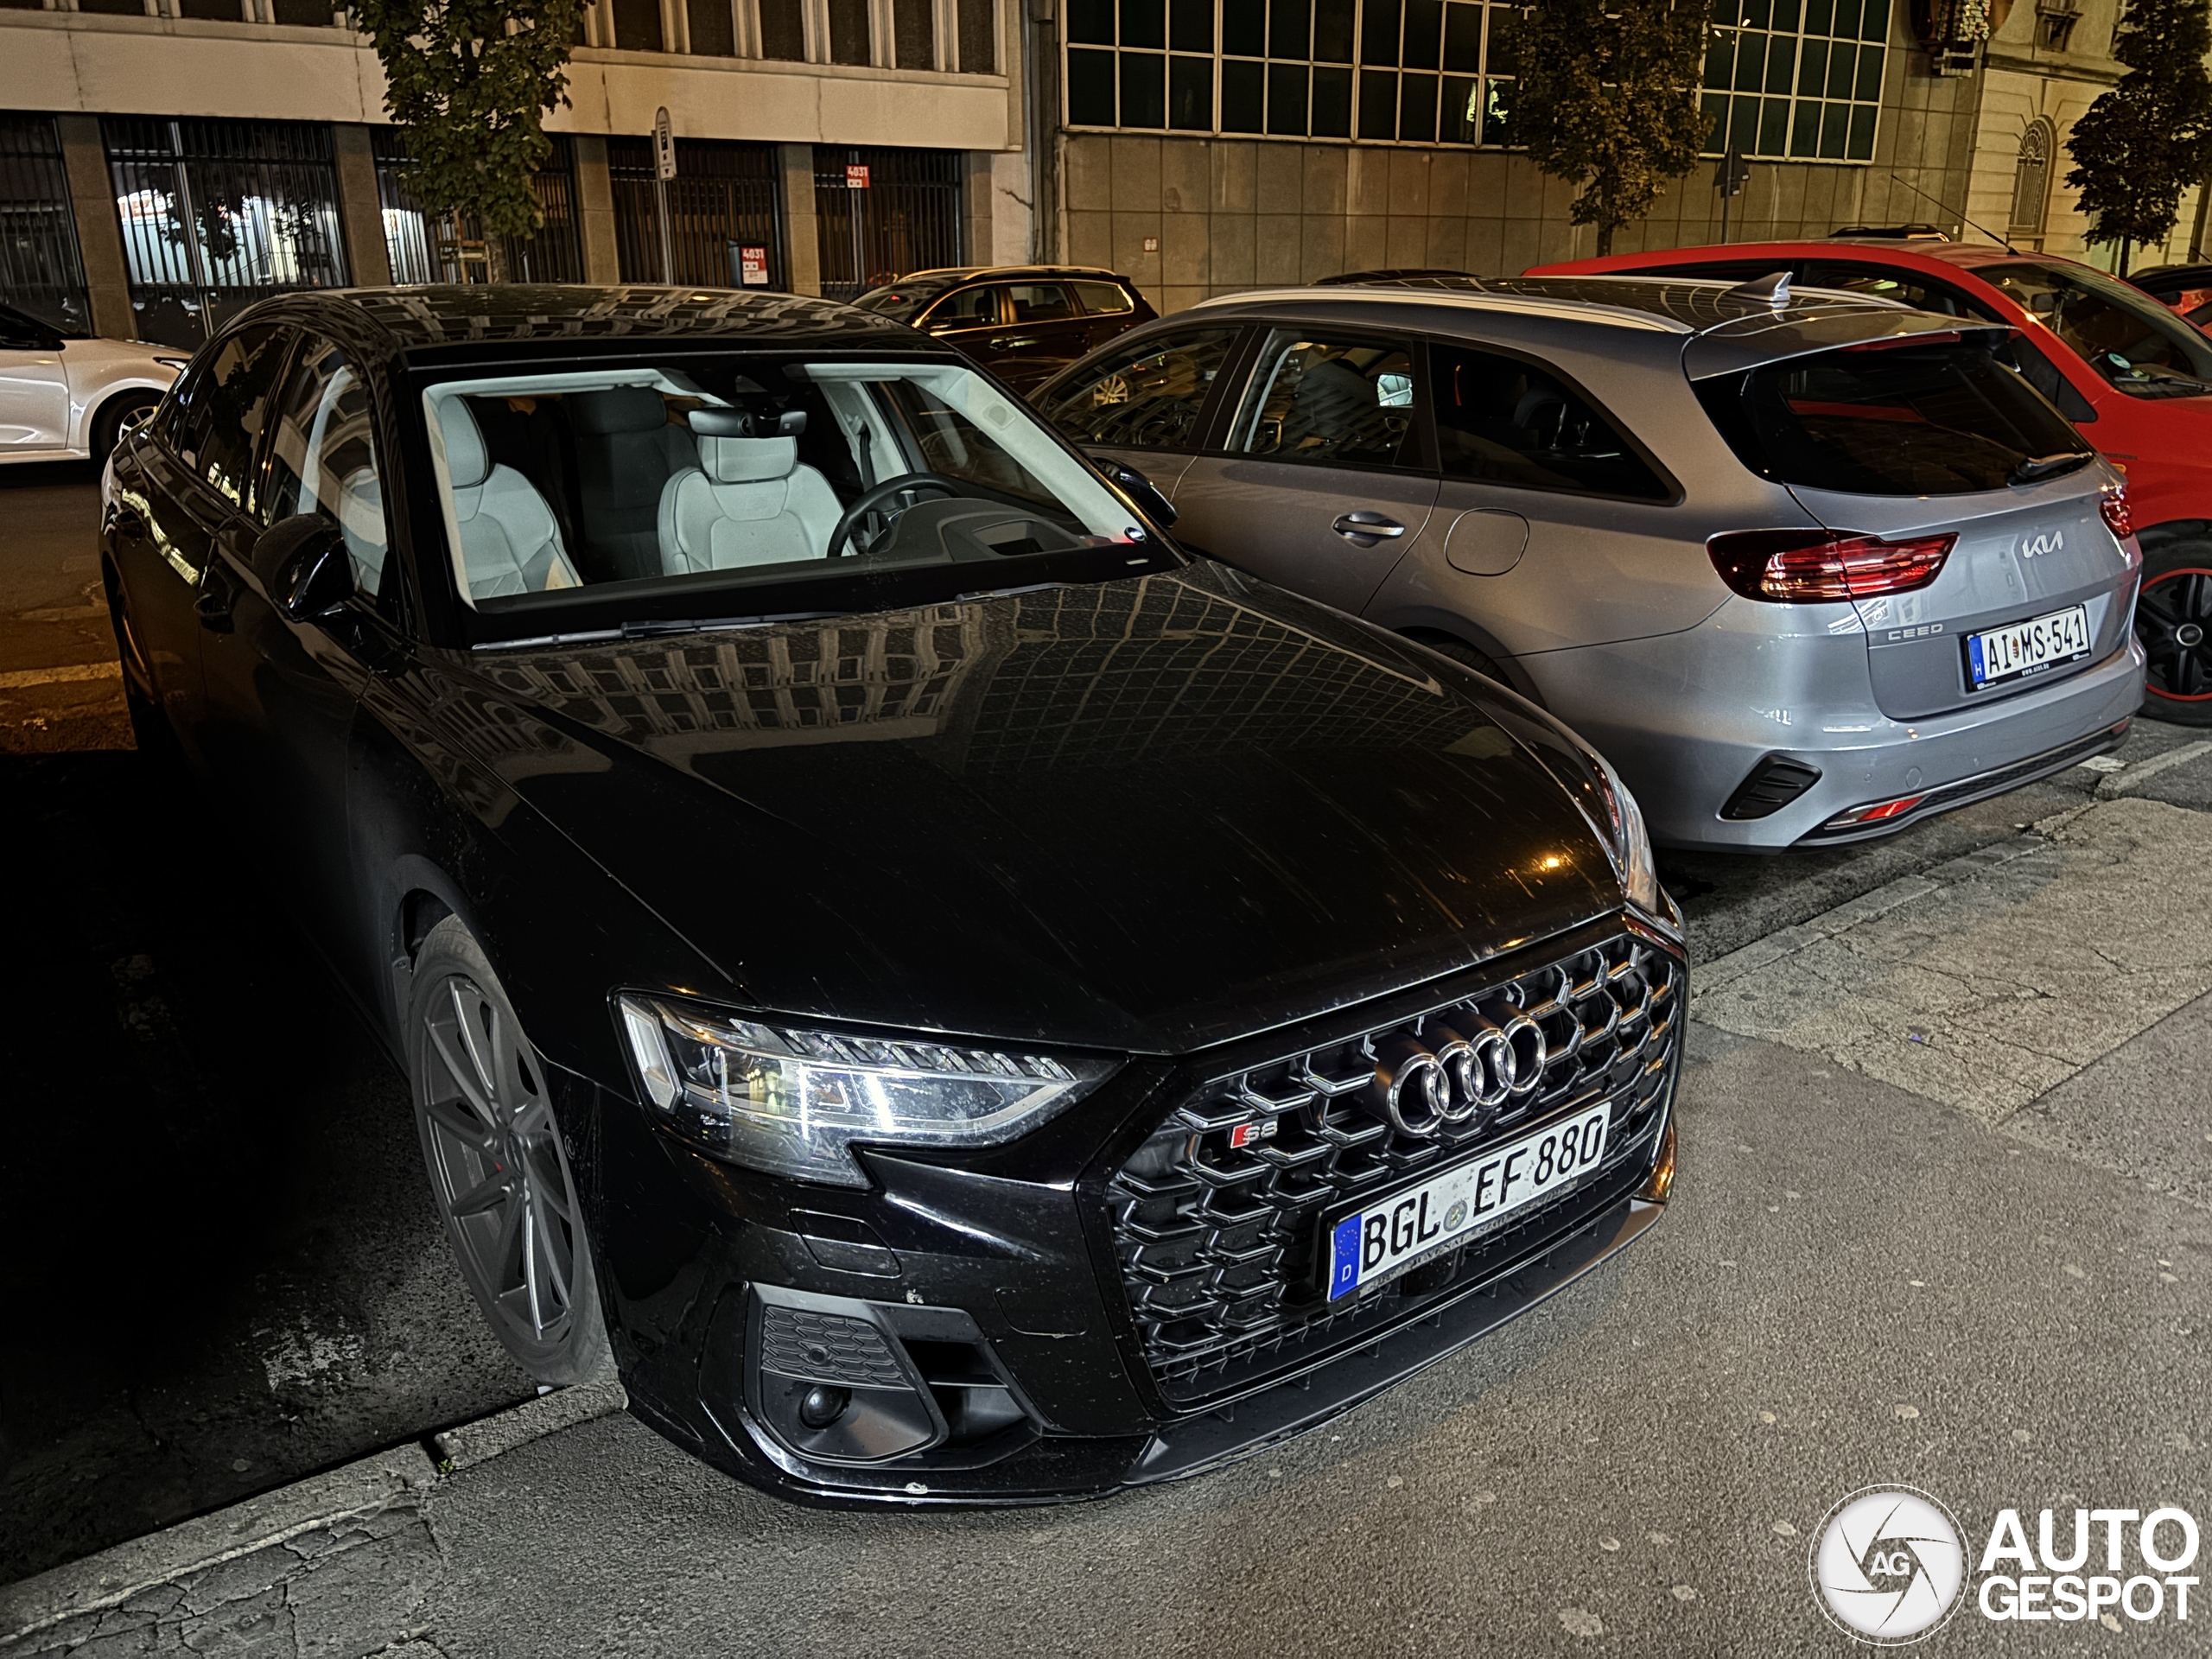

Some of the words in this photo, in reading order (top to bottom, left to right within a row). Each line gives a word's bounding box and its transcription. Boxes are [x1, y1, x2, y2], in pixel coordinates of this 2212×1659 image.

[848, 167, 868, 177] 4031
[743, 248, 764, 259] 4031
[2022, 531, 2063, 559] KIA
[1888, 623, 1943, 641] CEED
[1989, 634, 2012, 674] AI
[1974, 663, 1983, 677] H
[1243, 1121, 1278, 1141] S8
[1362, 1191, 1441, 1274] BGL
[1473, 1147, 1529, 1217] EF
[1534, 1115, 1604, 1185] 880
[1341, 1264, 1351, 1282] D
